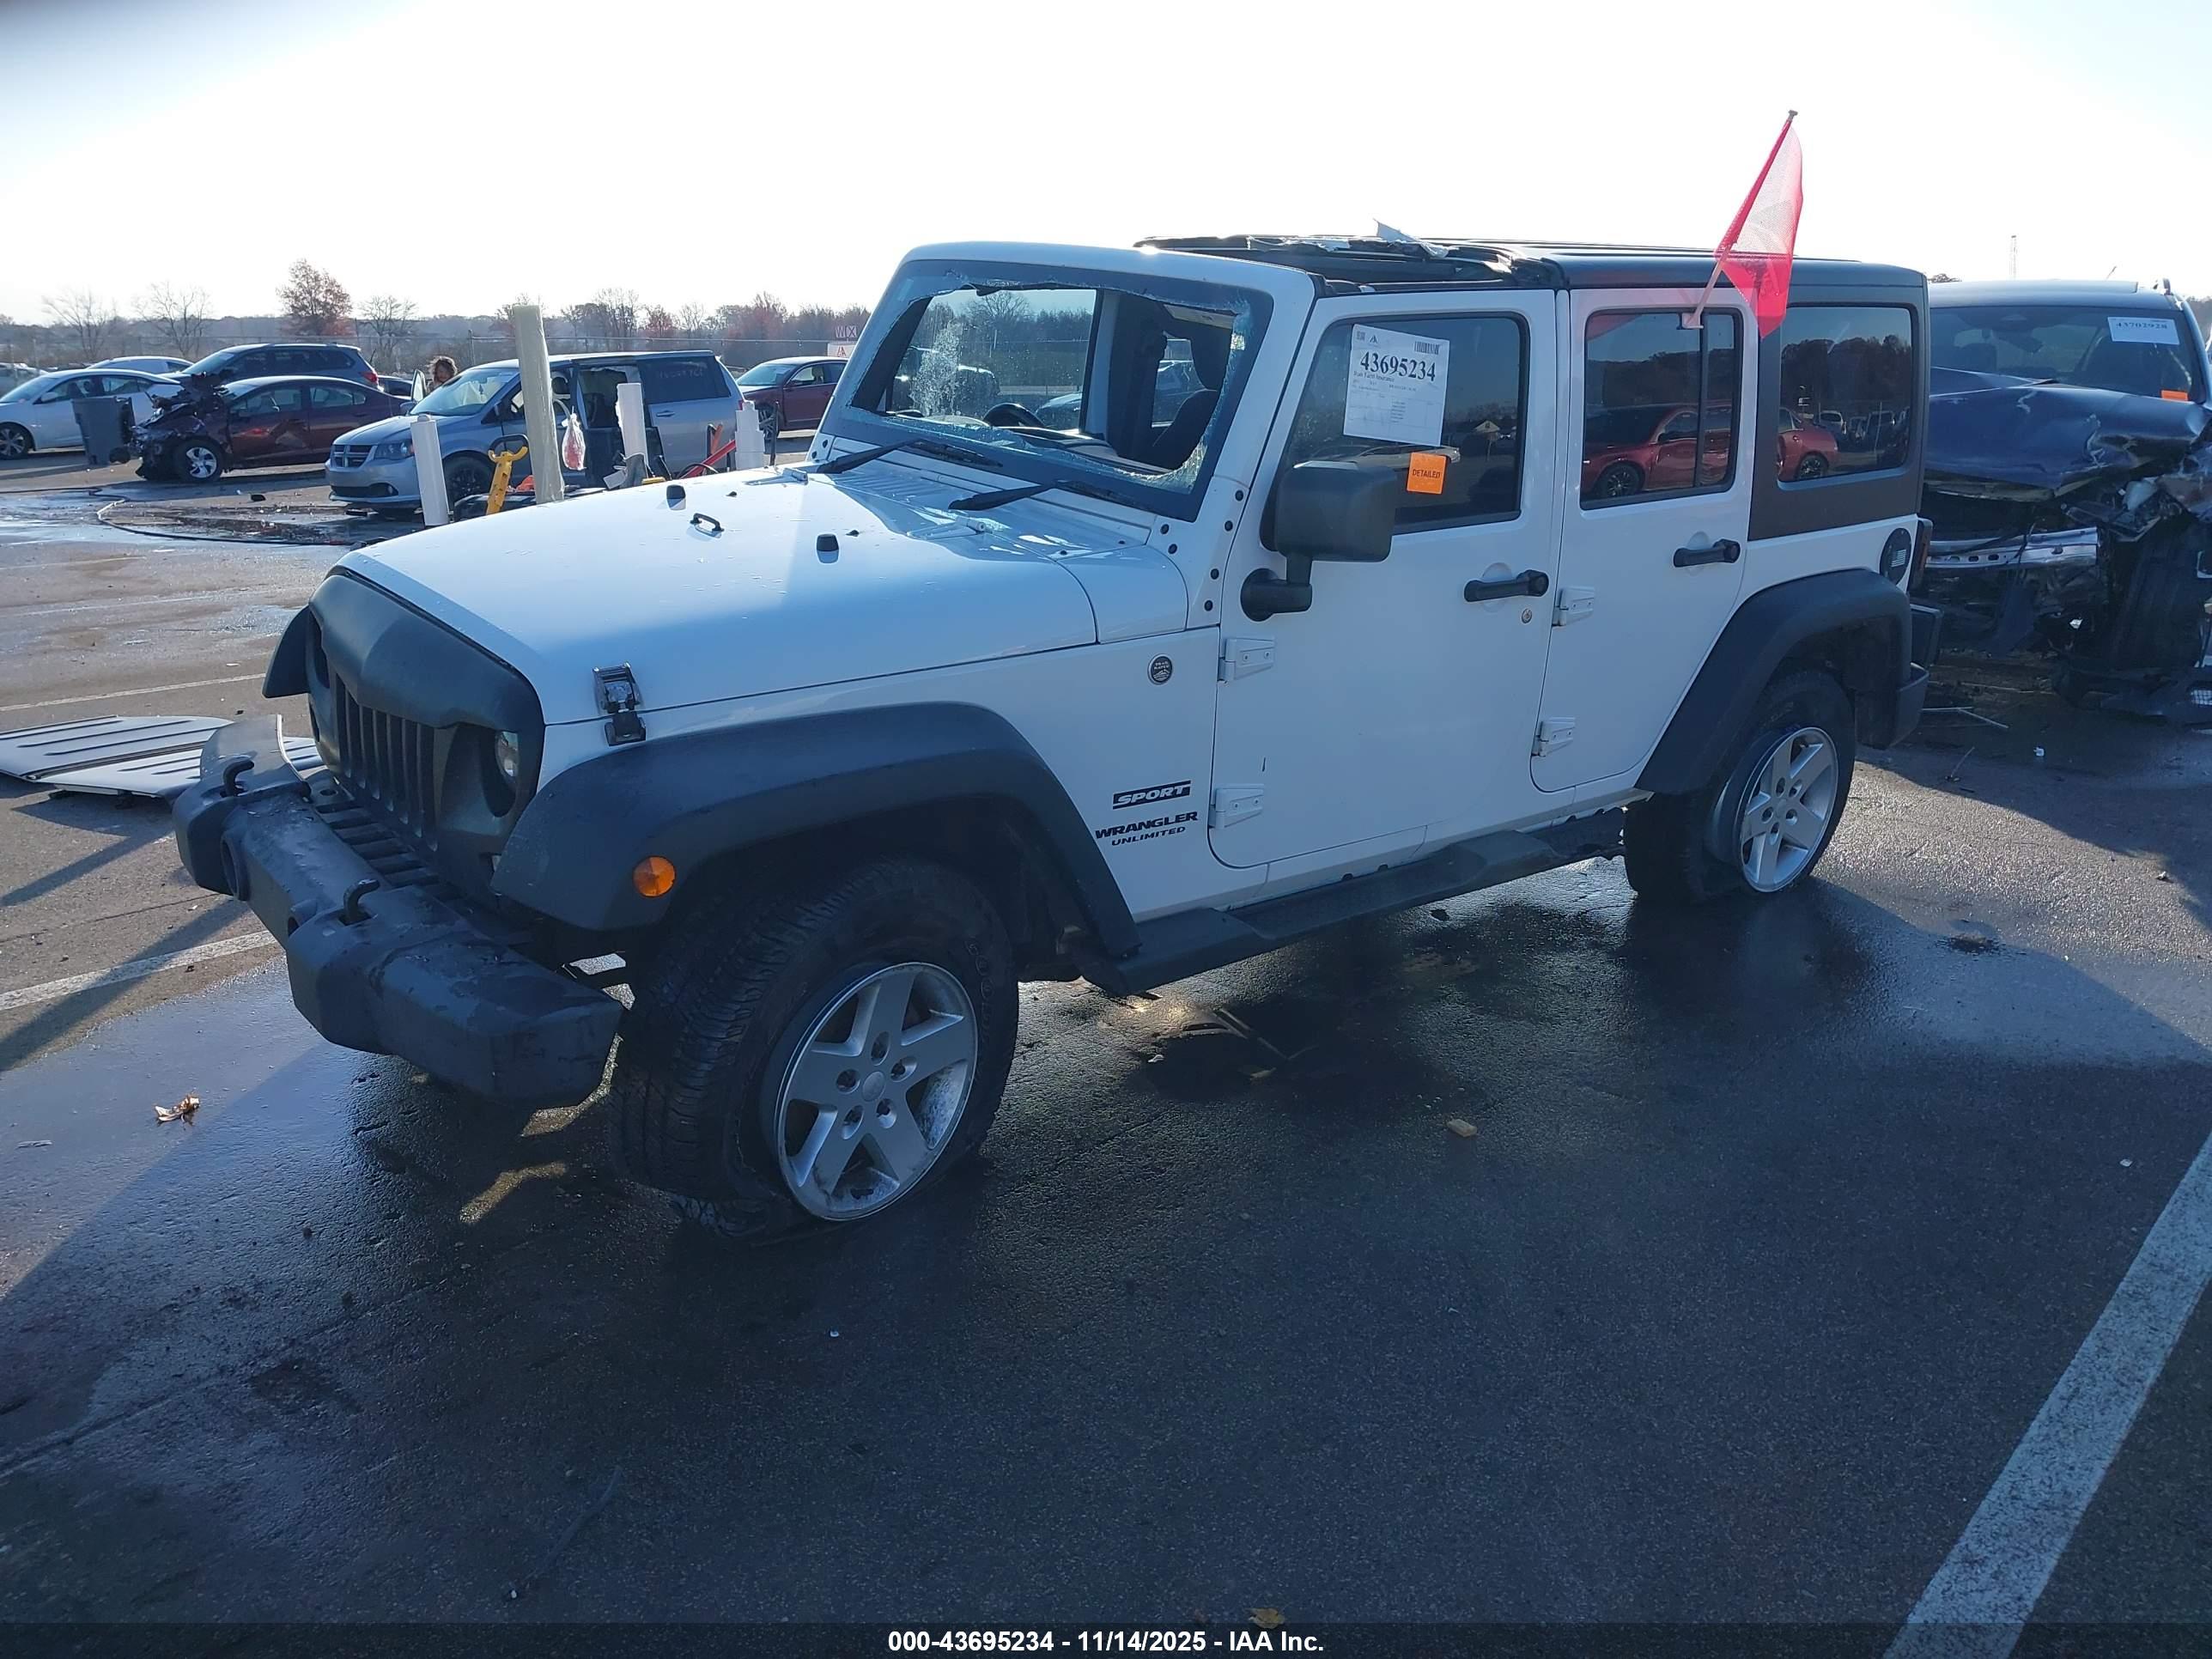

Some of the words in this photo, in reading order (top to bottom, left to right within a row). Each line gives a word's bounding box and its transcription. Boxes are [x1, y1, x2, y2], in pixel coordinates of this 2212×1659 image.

[1360, 351, 1436, 382] 43695234
[1413, 469, 1441, 478] DETAILED
[1116, 785, 1187, 805] SPORT
[1095, 811, 1199, 839] WRANGLER
[1111, 827, 1186, 846] UNLIMITED
